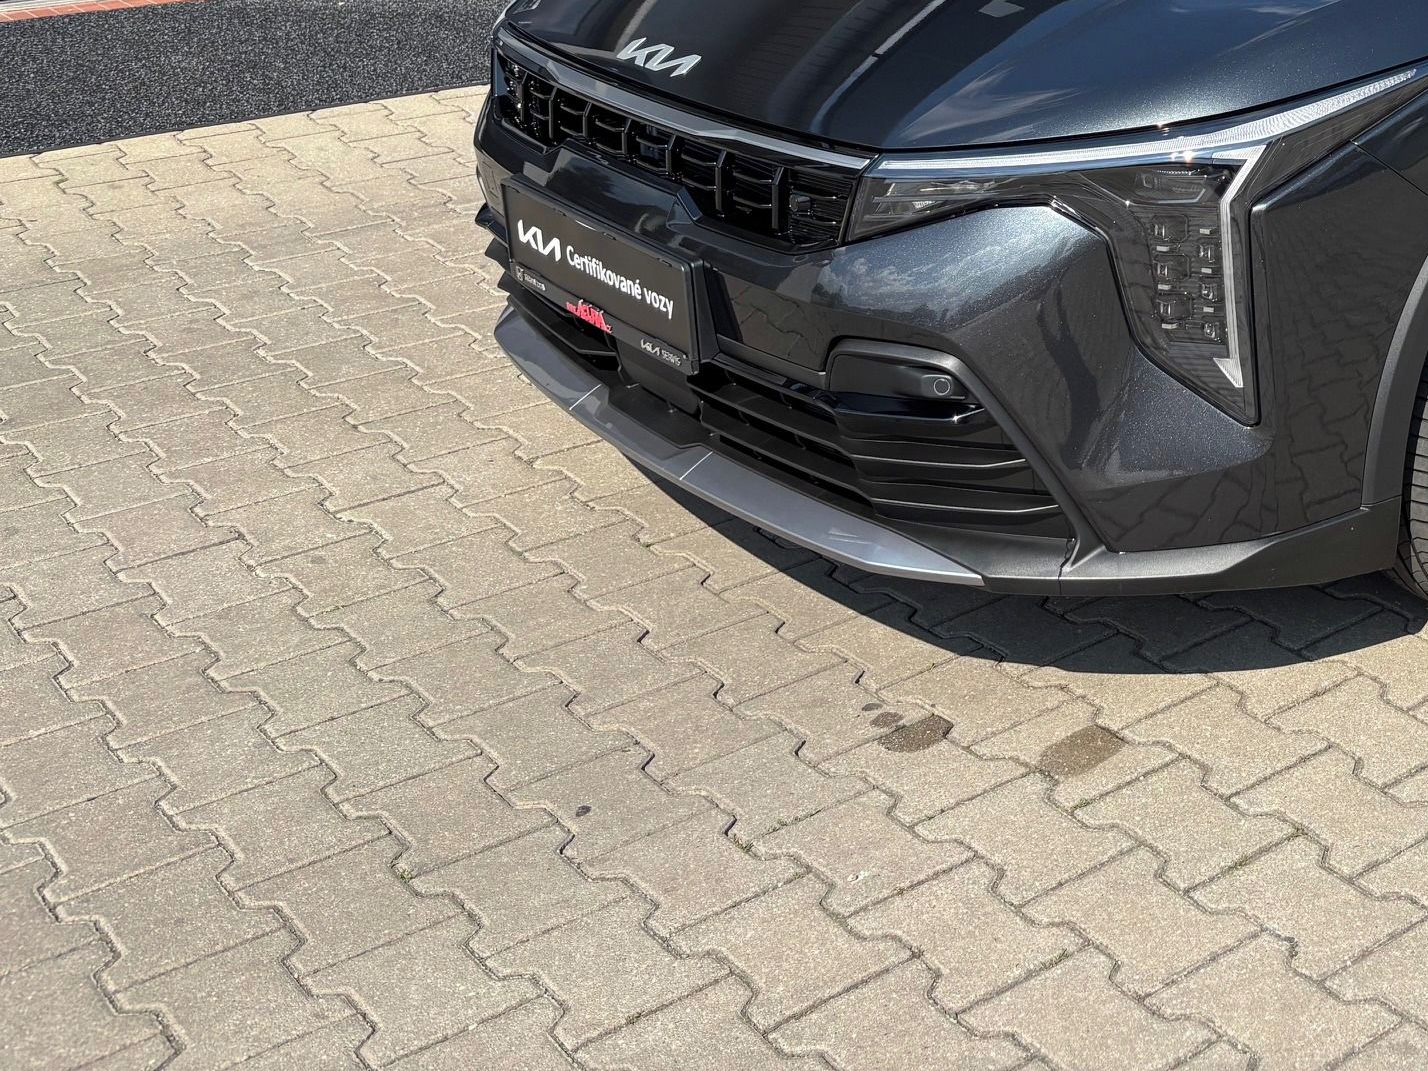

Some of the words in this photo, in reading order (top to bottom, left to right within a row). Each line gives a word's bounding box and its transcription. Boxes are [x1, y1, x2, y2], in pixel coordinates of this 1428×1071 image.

[616, 37, 702, 77] KIA
[517, 219, 562, 262] KIA
[566, 245, 642, 300] Certifikované
[643, 287, 674, 320] vozy
